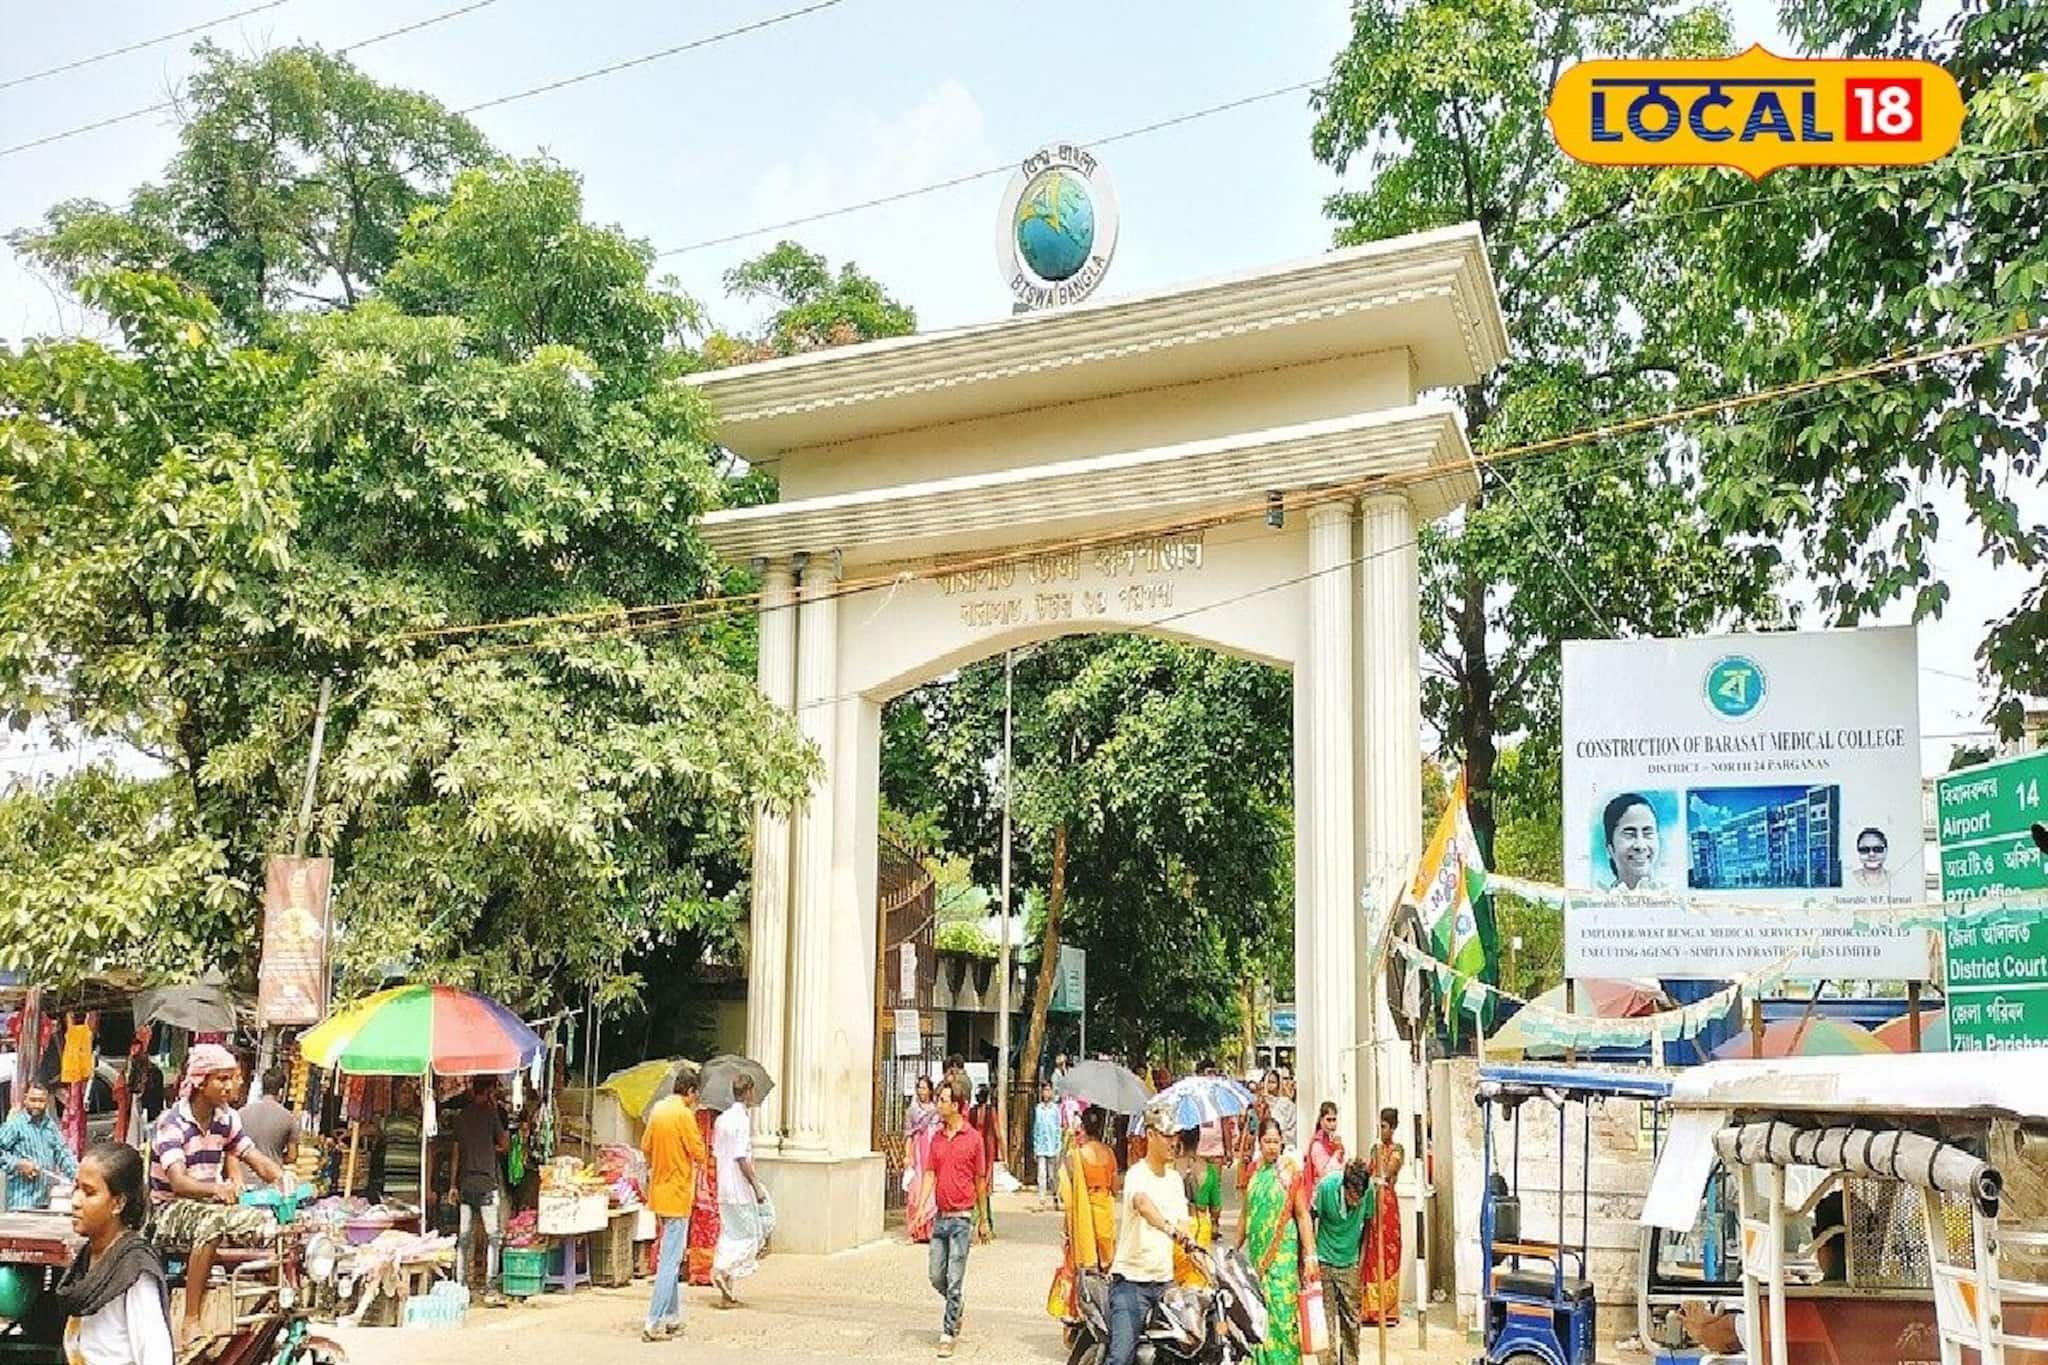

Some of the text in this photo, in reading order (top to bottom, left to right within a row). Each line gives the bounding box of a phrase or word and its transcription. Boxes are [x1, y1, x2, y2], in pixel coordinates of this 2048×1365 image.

[1011, 255, 1105, 309] BISWA BANGLA
[1576, 727, 1905, 759] CONSTRUCTION OF BARASAT MEDICAL COLLEGE
[1647, 762, 1699, 774] DISTRICT
[1712, 761, 1751, 773] NORTH
[1754, 760, 1765, 772] 24
[1767, 759, 1831, 771] PARGANAS
[2015, 778, 2041, 811] 14
[1943, 810, 1991, 840] Airport
[1949, 954, 2048, 980] District Court
[1953, 1033, 1982, 1052] Zilla
